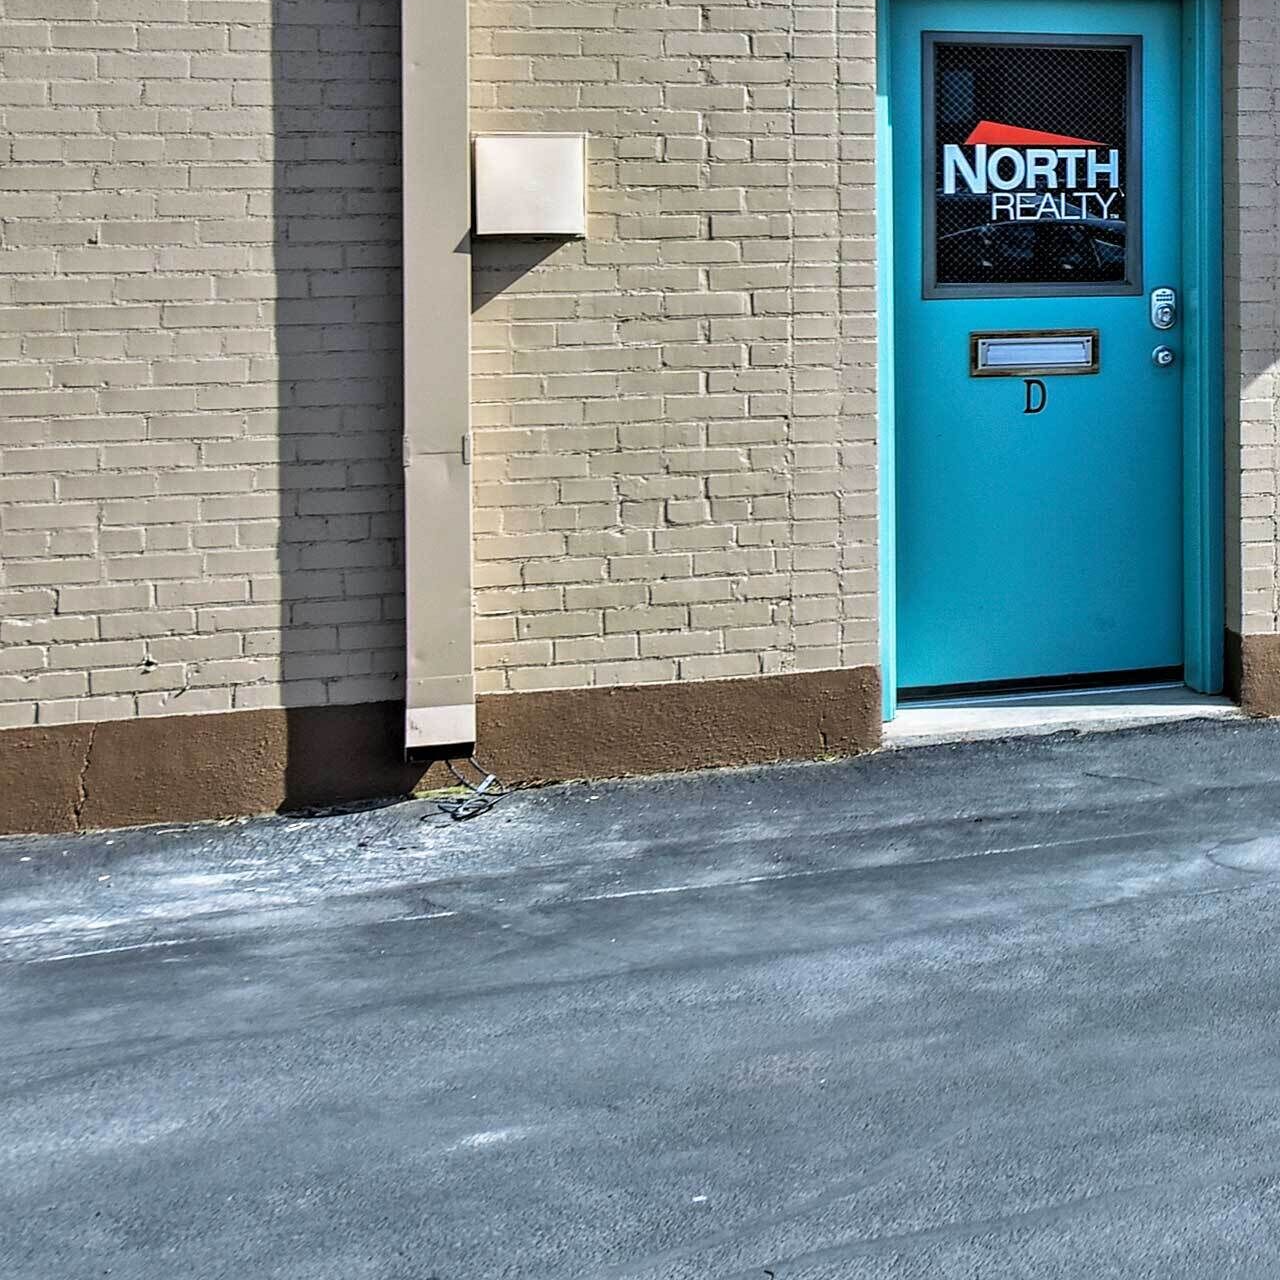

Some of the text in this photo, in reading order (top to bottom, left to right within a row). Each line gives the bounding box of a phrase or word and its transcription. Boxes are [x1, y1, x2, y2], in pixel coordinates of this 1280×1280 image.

[943, 143, 1119, 195] NORTH
[991, 192, 1117, 220] REALTY
[1022, 378, 1047, 414] D
